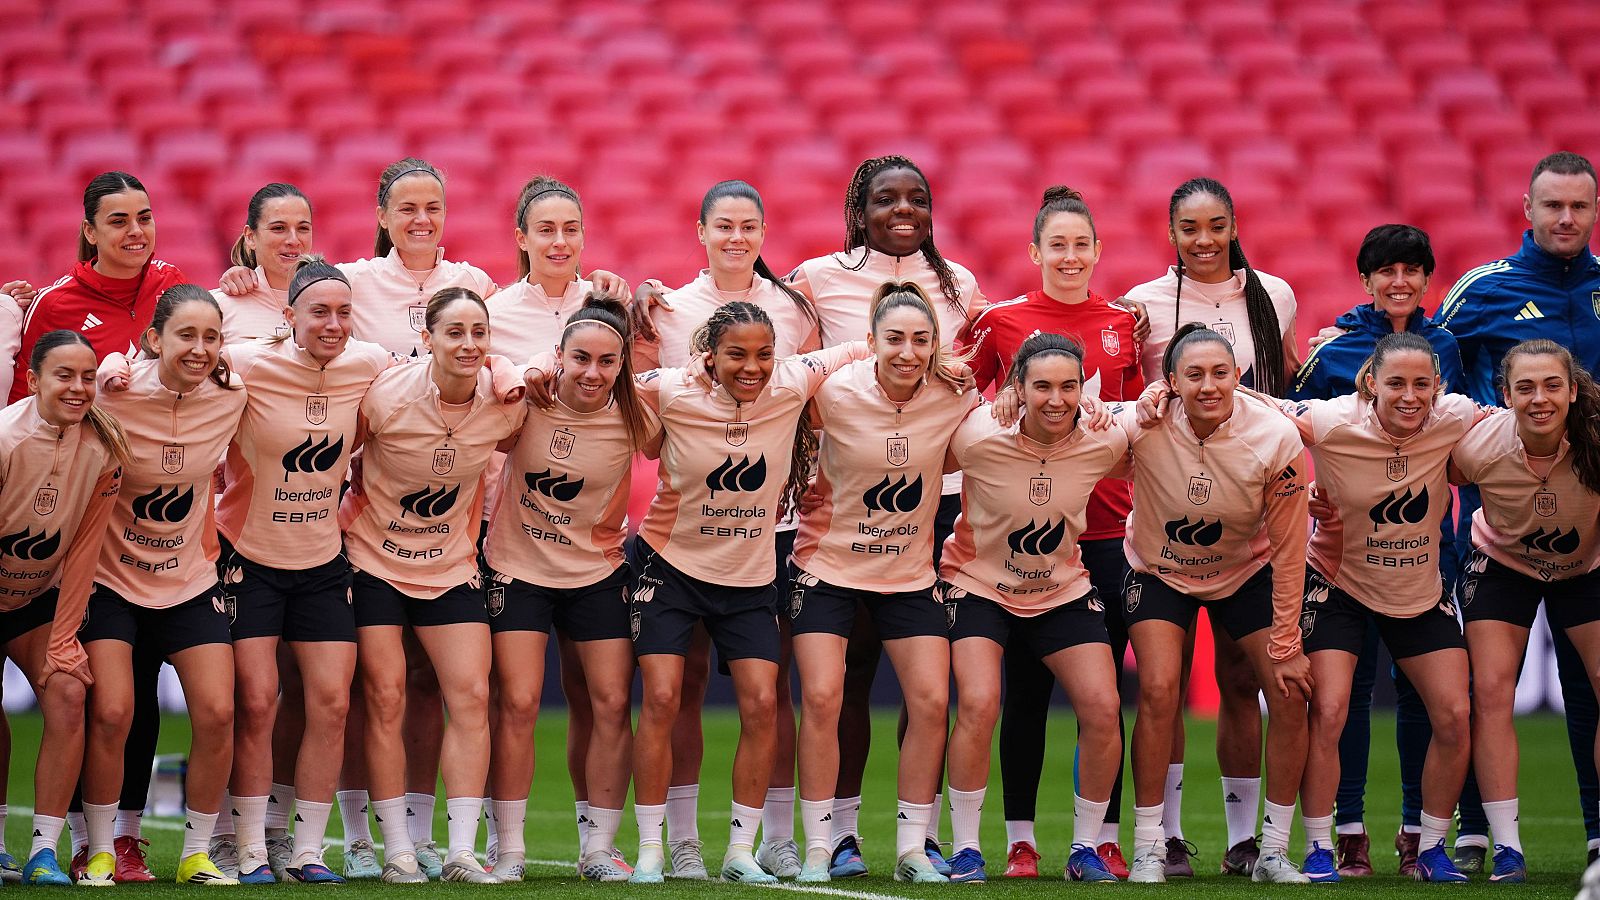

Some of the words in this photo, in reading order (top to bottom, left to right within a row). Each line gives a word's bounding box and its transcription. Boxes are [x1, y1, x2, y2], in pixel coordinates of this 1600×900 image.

[1446, 297, 1467, 322] mapfre
[1301, 357, 1320, 384] mapfre
[274, 487, 333, 502] Iberdrola
[1275, 485, 1306, 498] mapfre
[272, 508, 329, 523] EBRO
[520, 493, 571, 525] Iberdrola
[701, 504, 766, 519] Iberdrola
[123, 527, 184, 549] Iberdrola
[521, 522, 572, 545] EBRO
[700, 526, 762, 539] EBRO
[1366, 534, 1430, 550] Iberdrola
[382, 539, 443, 560] EBRO
[1160, 545, 1223, 566] Iberdrola
[119, 553, 179, 573] EBRO
[1366, 552, 1429, 568] EBRO
